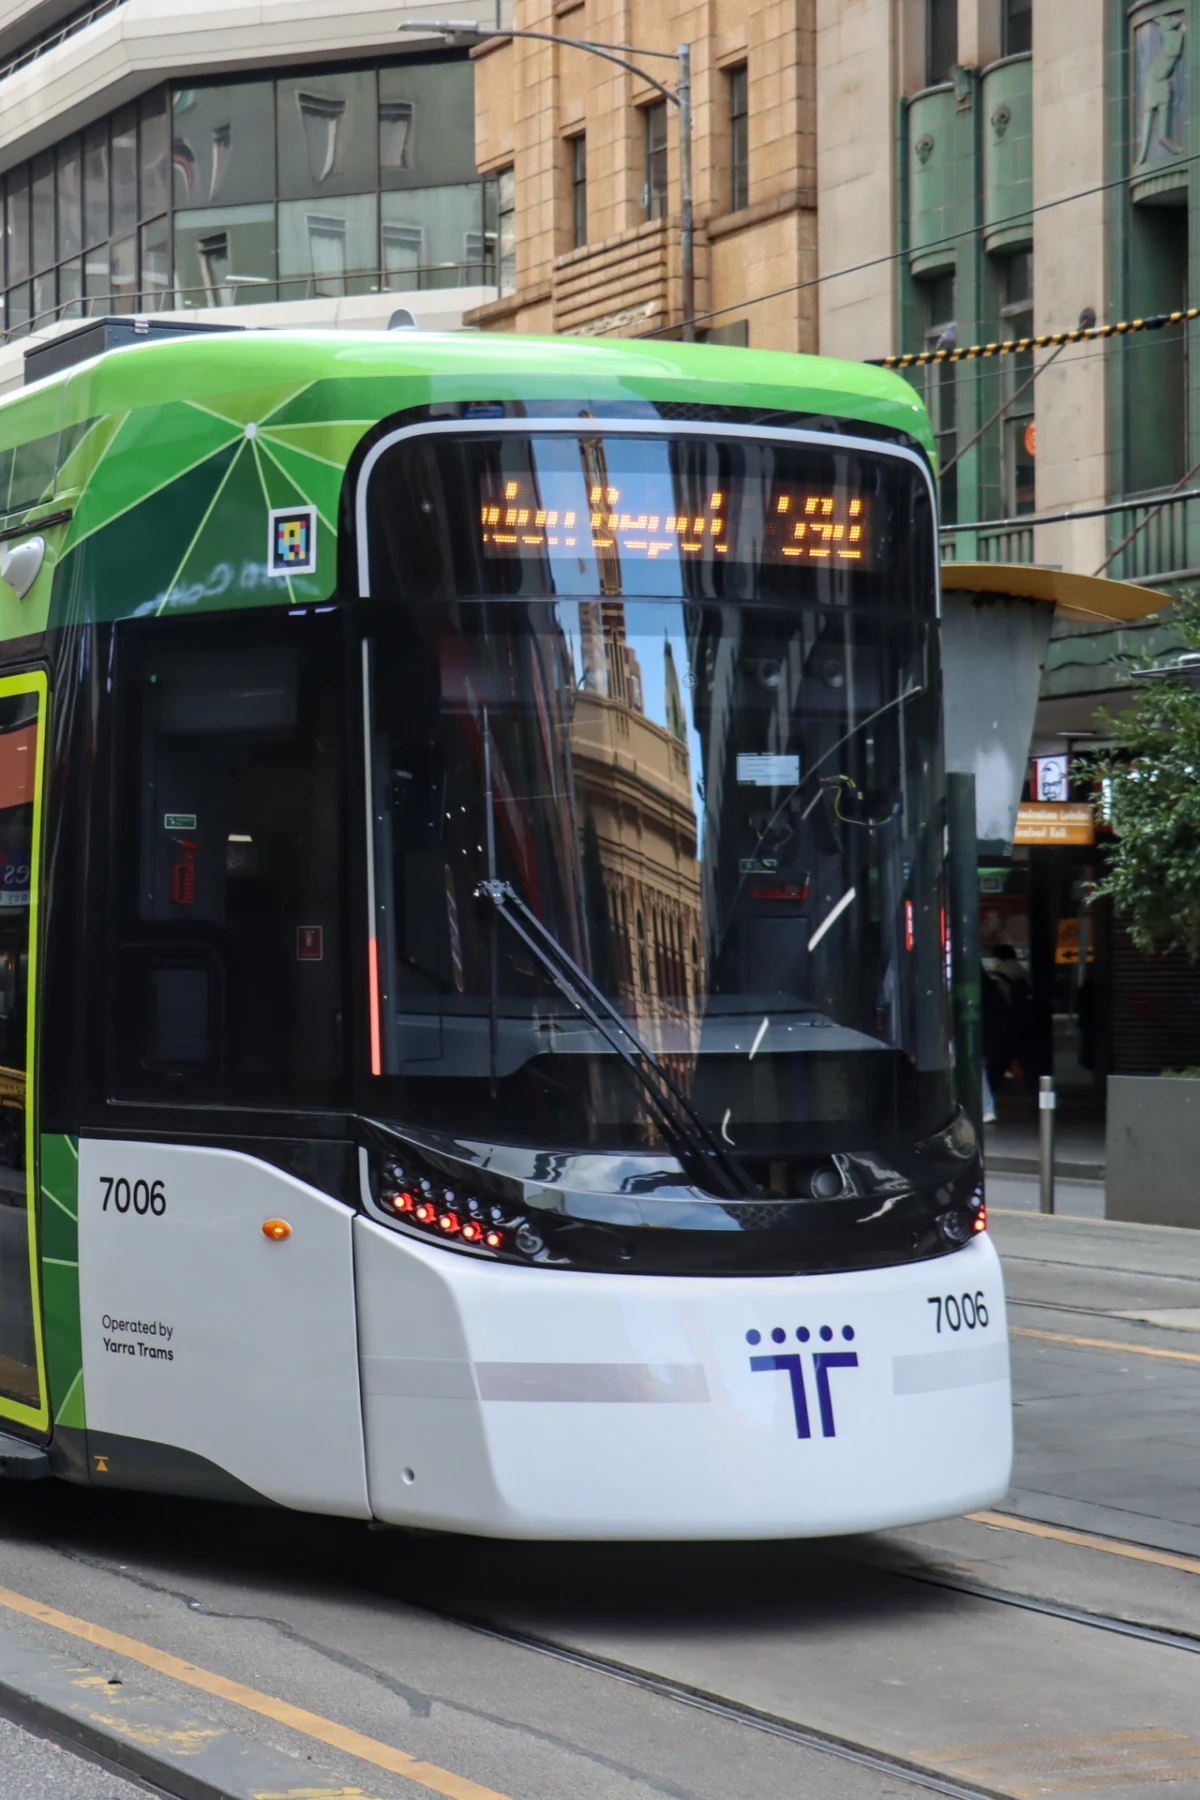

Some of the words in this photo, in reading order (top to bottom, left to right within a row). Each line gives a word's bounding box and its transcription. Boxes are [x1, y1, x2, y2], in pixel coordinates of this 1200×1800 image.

[99, 1176, 167, 1216] 7006
[102, 1314, 157, 1335] Operated
[159, 1322, 174, 1341] by
[926, 1291, 989, 1334] 7006
[103, 1337, 136, 1356] Yarra
[137, 1342, 174, 1361] Trams
